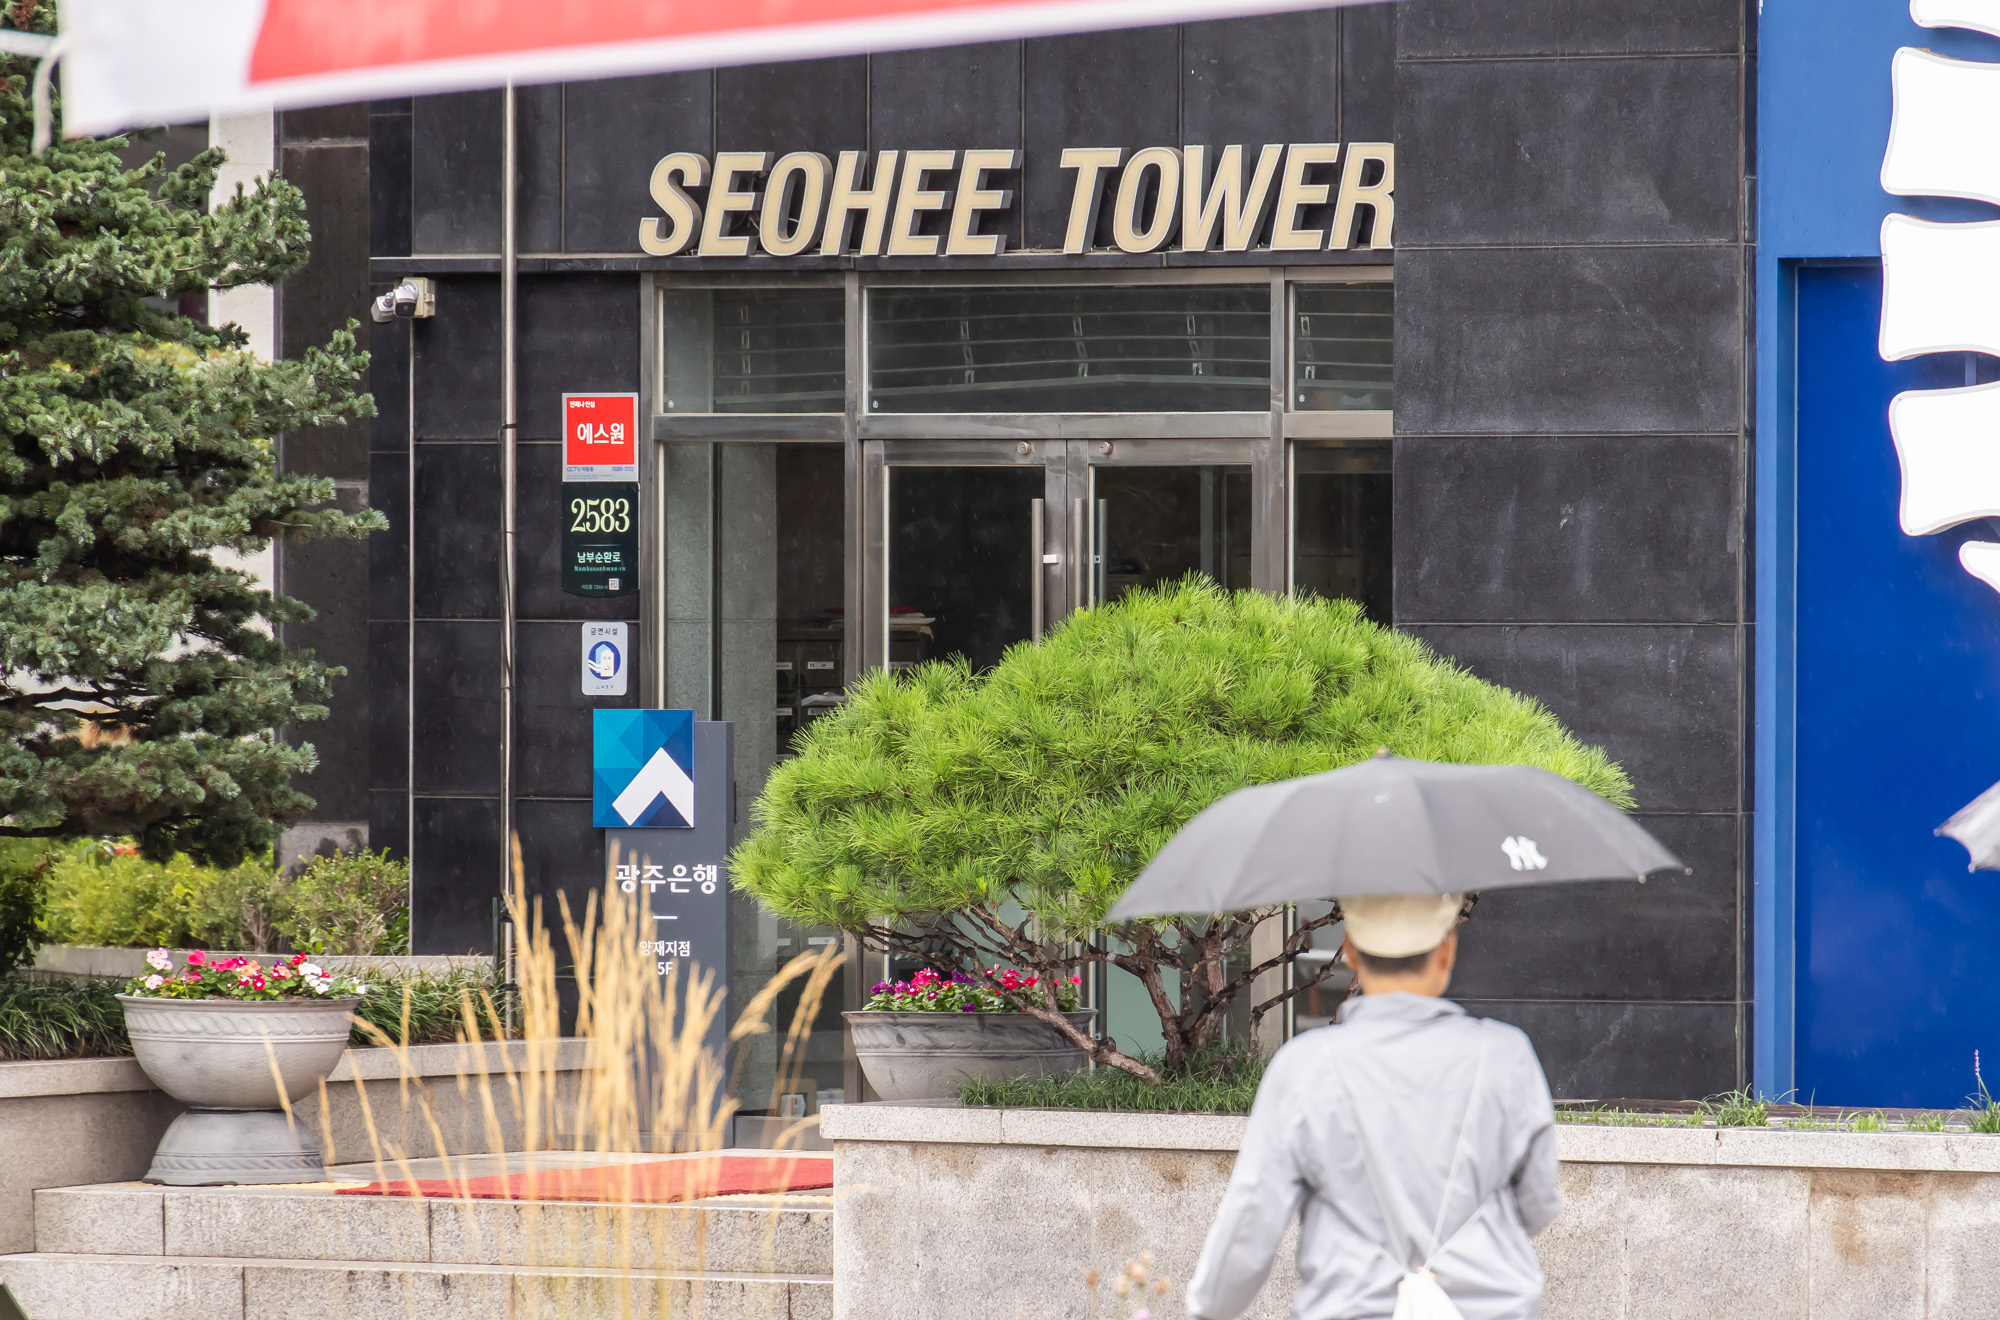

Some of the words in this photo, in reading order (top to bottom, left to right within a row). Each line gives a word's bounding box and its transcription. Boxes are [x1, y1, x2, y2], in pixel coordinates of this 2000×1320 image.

[638, 148, 1018, 257] SEOHEE
[1060, 142, 1394, 254] TOWER
[577, 423, 624, 444] 에스원
[570, 498, 630, 533] 2583
[577, 551, 621, 564] 남부순환로
[590, 627, 618, 636] 금연시설
[614, 864, 718, 895] 광주은행
[639, 940, 691, 957] 양재지점
[657, 961, 674, 976] 5F
